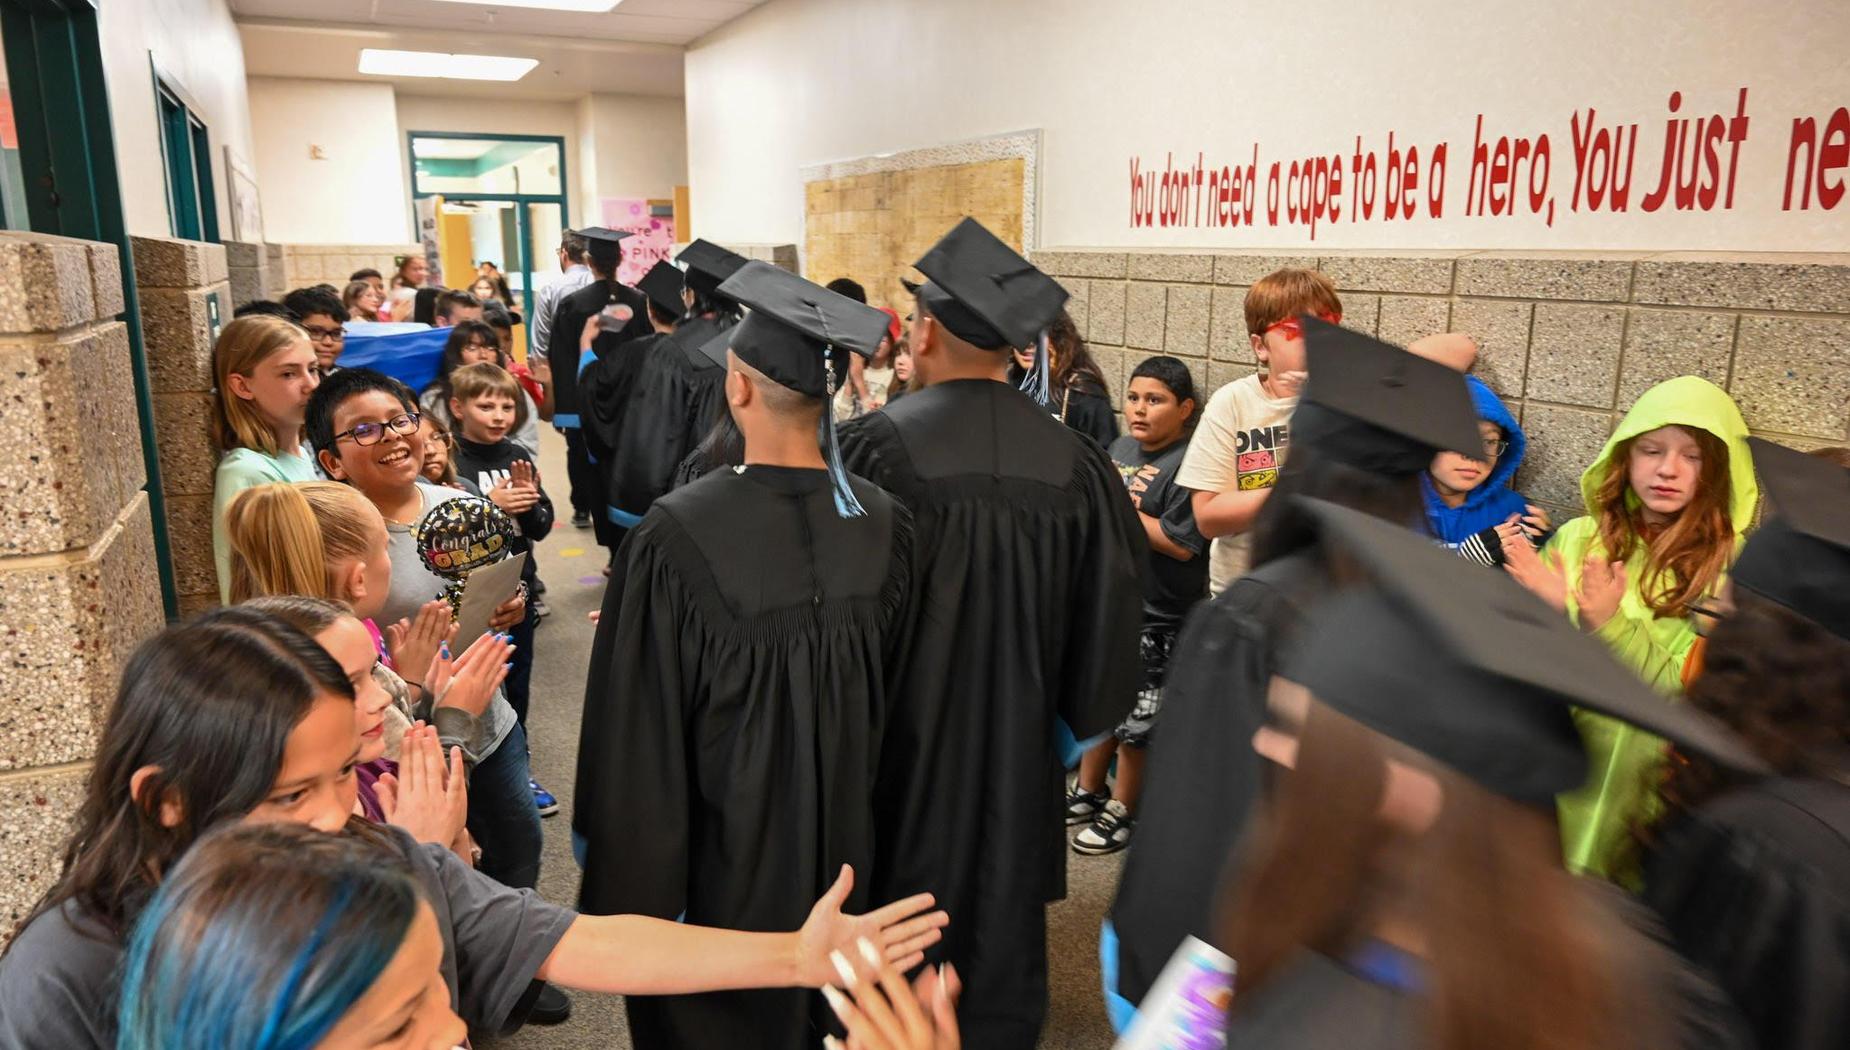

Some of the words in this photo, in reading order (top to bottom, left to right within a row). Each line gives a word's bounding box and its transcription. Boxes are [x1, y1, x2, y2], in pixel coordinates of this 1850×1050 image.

[1129, 156, 1156, 228] You
[1159, 152, 1204, 228] don't
[1206, 143, 1259, 227] need
[1266, 161, 1281, 227] a
[1287, 154, 1343, 240] cape
[1352, 135, 1377, 223] to
[1383, 131, 1420, 221] be
[1428, 142, 1449, 219] a
[1465, 114, 1556, 228] hero,
[1571, 107, 1639, 212] You
[1640, 87, 1750, 212] just
[632, 247, 671, 260] PINK
[1236, 424, 1288, 454] ONE
[432, 520, 497, 554] Congrats
[433, 533, 504, 569] GRAD
